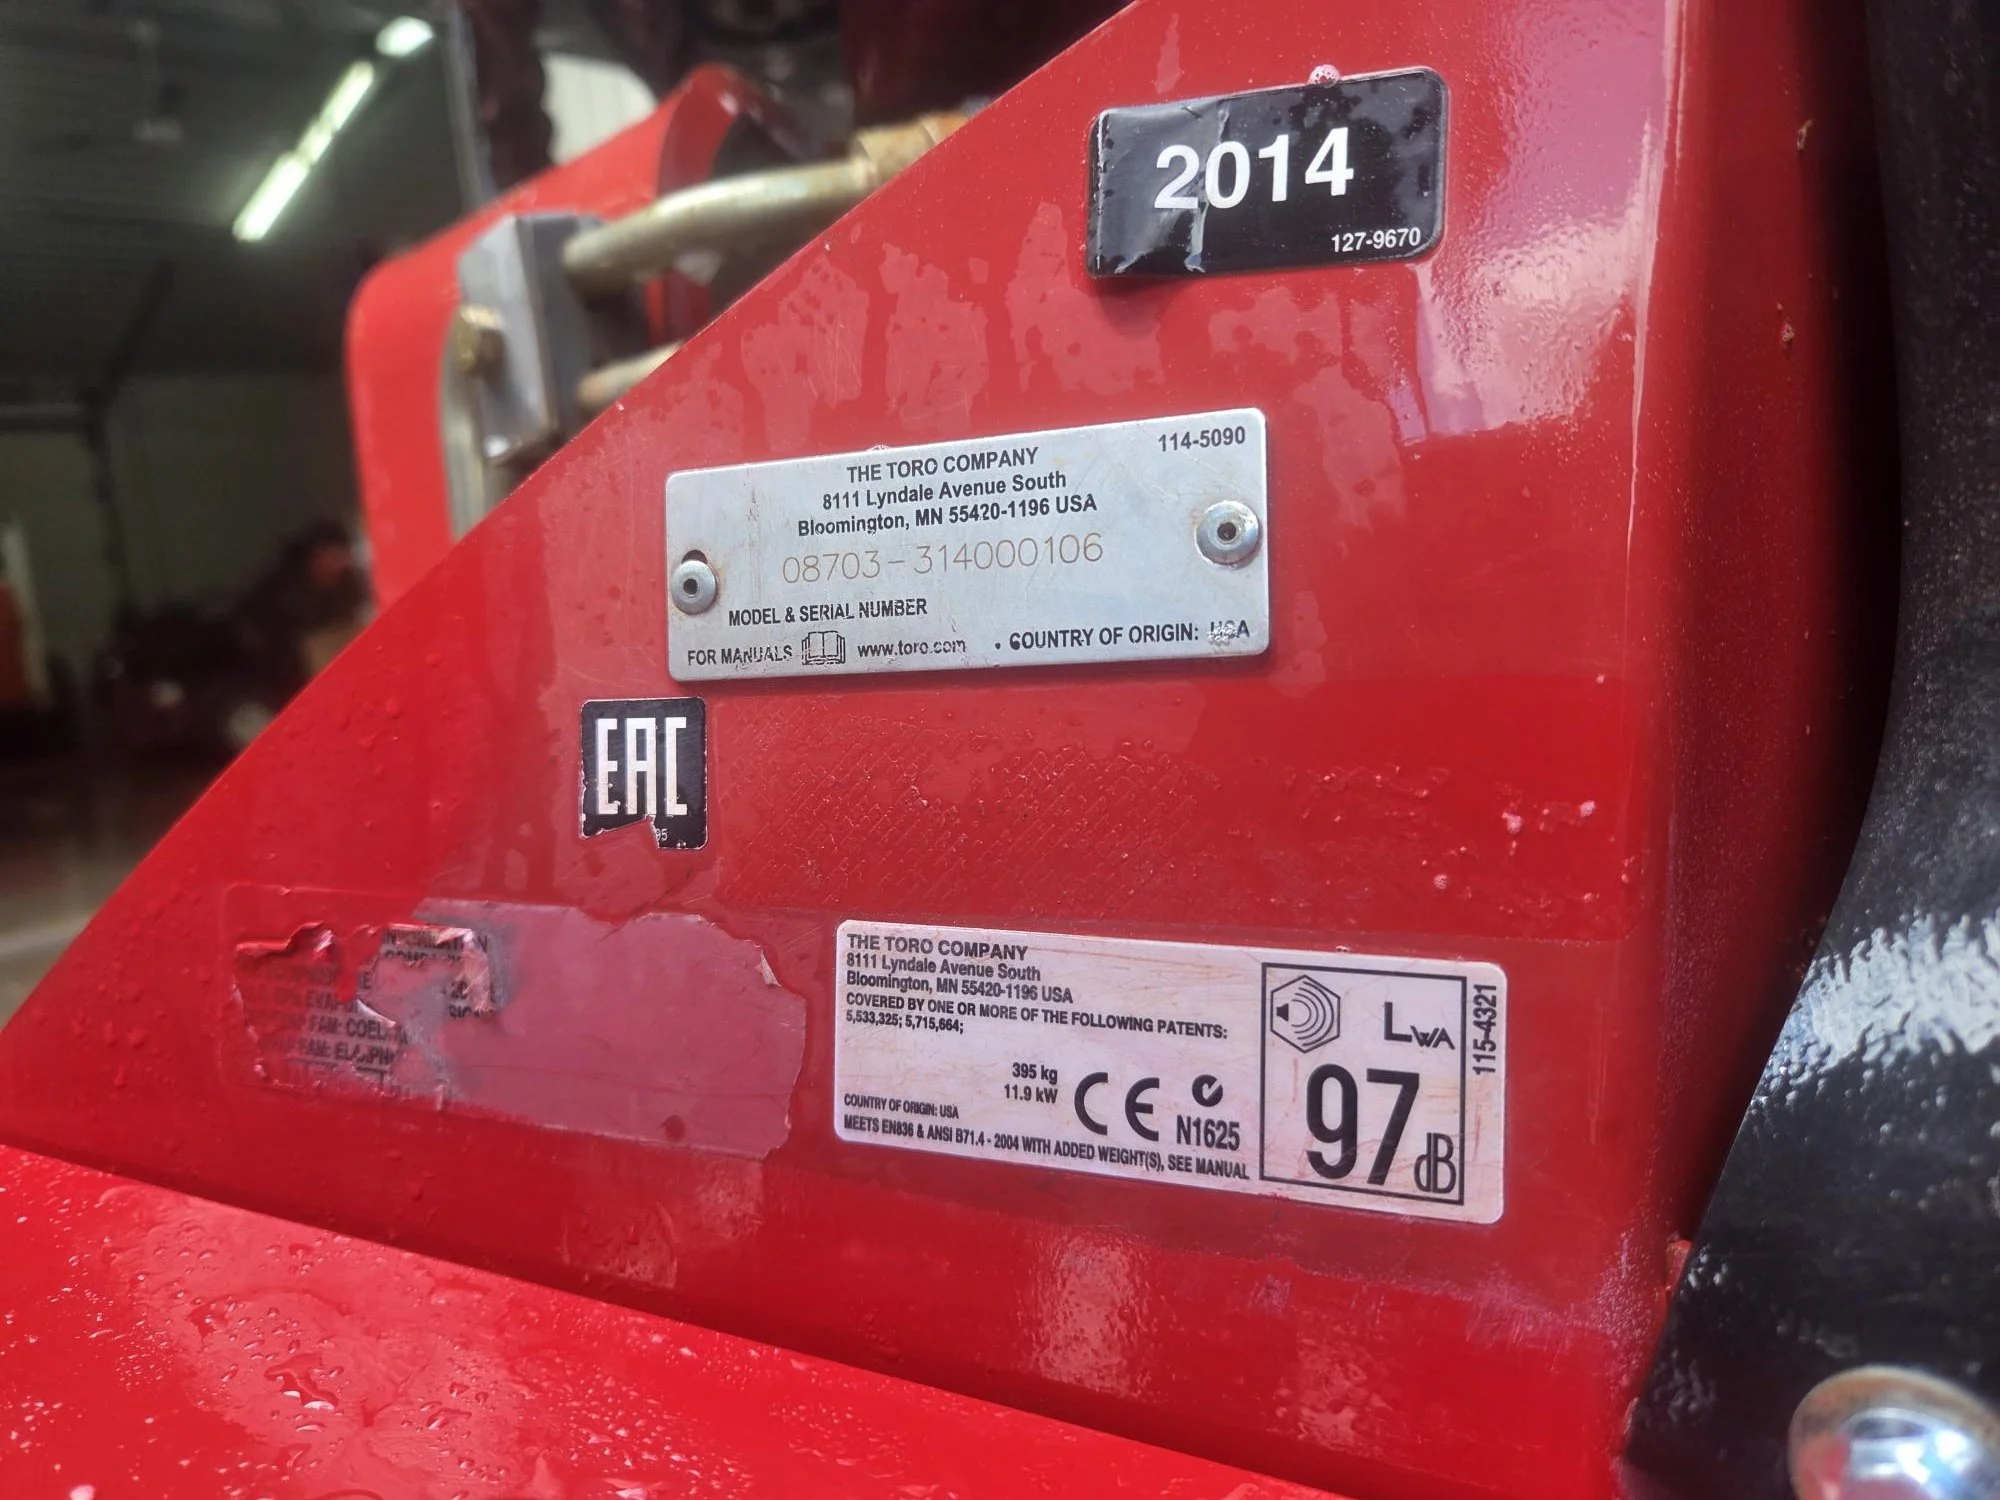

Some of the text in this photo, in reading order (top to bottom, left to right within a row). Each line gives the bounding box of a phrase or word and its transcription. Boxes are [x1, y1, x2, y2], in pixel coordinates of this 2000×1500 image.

[1154, 127, 1354, 209] 2014
[1332, 227, 1421, 253] 127-9670
[1158, 426, 1246, 452] 114-5090
[847, 447, 1038, 483] THE TORO COMPANY
[823, 470, 1066, 510] 8111 Lyndale Avenue South
[799, 493, 1097, 537] Bloomington, MN 55420-1196 USA
[729, 598, 927, 626] MODEL & SERIAL NUMBER
[688, 638, 966, 666] FOR MANUALS www.toro.com
[1010, 629, 1093, 649] COUNTRY
[1099, 627, 1123, 645] OF
[1128, 623, 1199, 643] ORIGIN:
[597, 717, 687, 815] EAC
[847, 933, 1028, 961] THE TORO COMPANY
[846, 953, 1041, 981] 8111 Lyndale Avenue South
[846, 970, 1073, 1003] Bloomington, MN 55420-1196 USA
[846, 992, 1227, 1039] COVERED BY ONE OR MORE OF THE FOLLOWING PATENTS:
[846, 1009, 964, 1034] 5,533,325; 5,715,664;
[1473, 984, 1497, 1075] 115-4321
[1012, 1062, 1058, 1085] 395 kg
[844, 1093, 959, 1119] COUNTRY OF ORIGIN: USA
[1004, 1084, 1058, 1104] 11.9 kW
[1074, 1072, 1160, 1142] CE
[1177, 1115, 1240, 1151] N1625
[1306, 1064, 1456, 1194] 97 dB
[844, 1114, 879, 1133] MEETS
[916, 1123, 924, 1138] &
[927, 1125, 953, 1142] ANSI
[955, 1127, 984, 1146] B71.4
[994, 1133, 1019, 1150] 2004
[1022, 1136, 1050, 1154] WITH
[1053, 1142, 1095, 1160] ADDED
[1098, 1146, 1164, 1172] WEIGHT(S),
[1168, 1154, 1192, 1172] SEE
[1196, 1158, 1250, 1180] MANUAL
